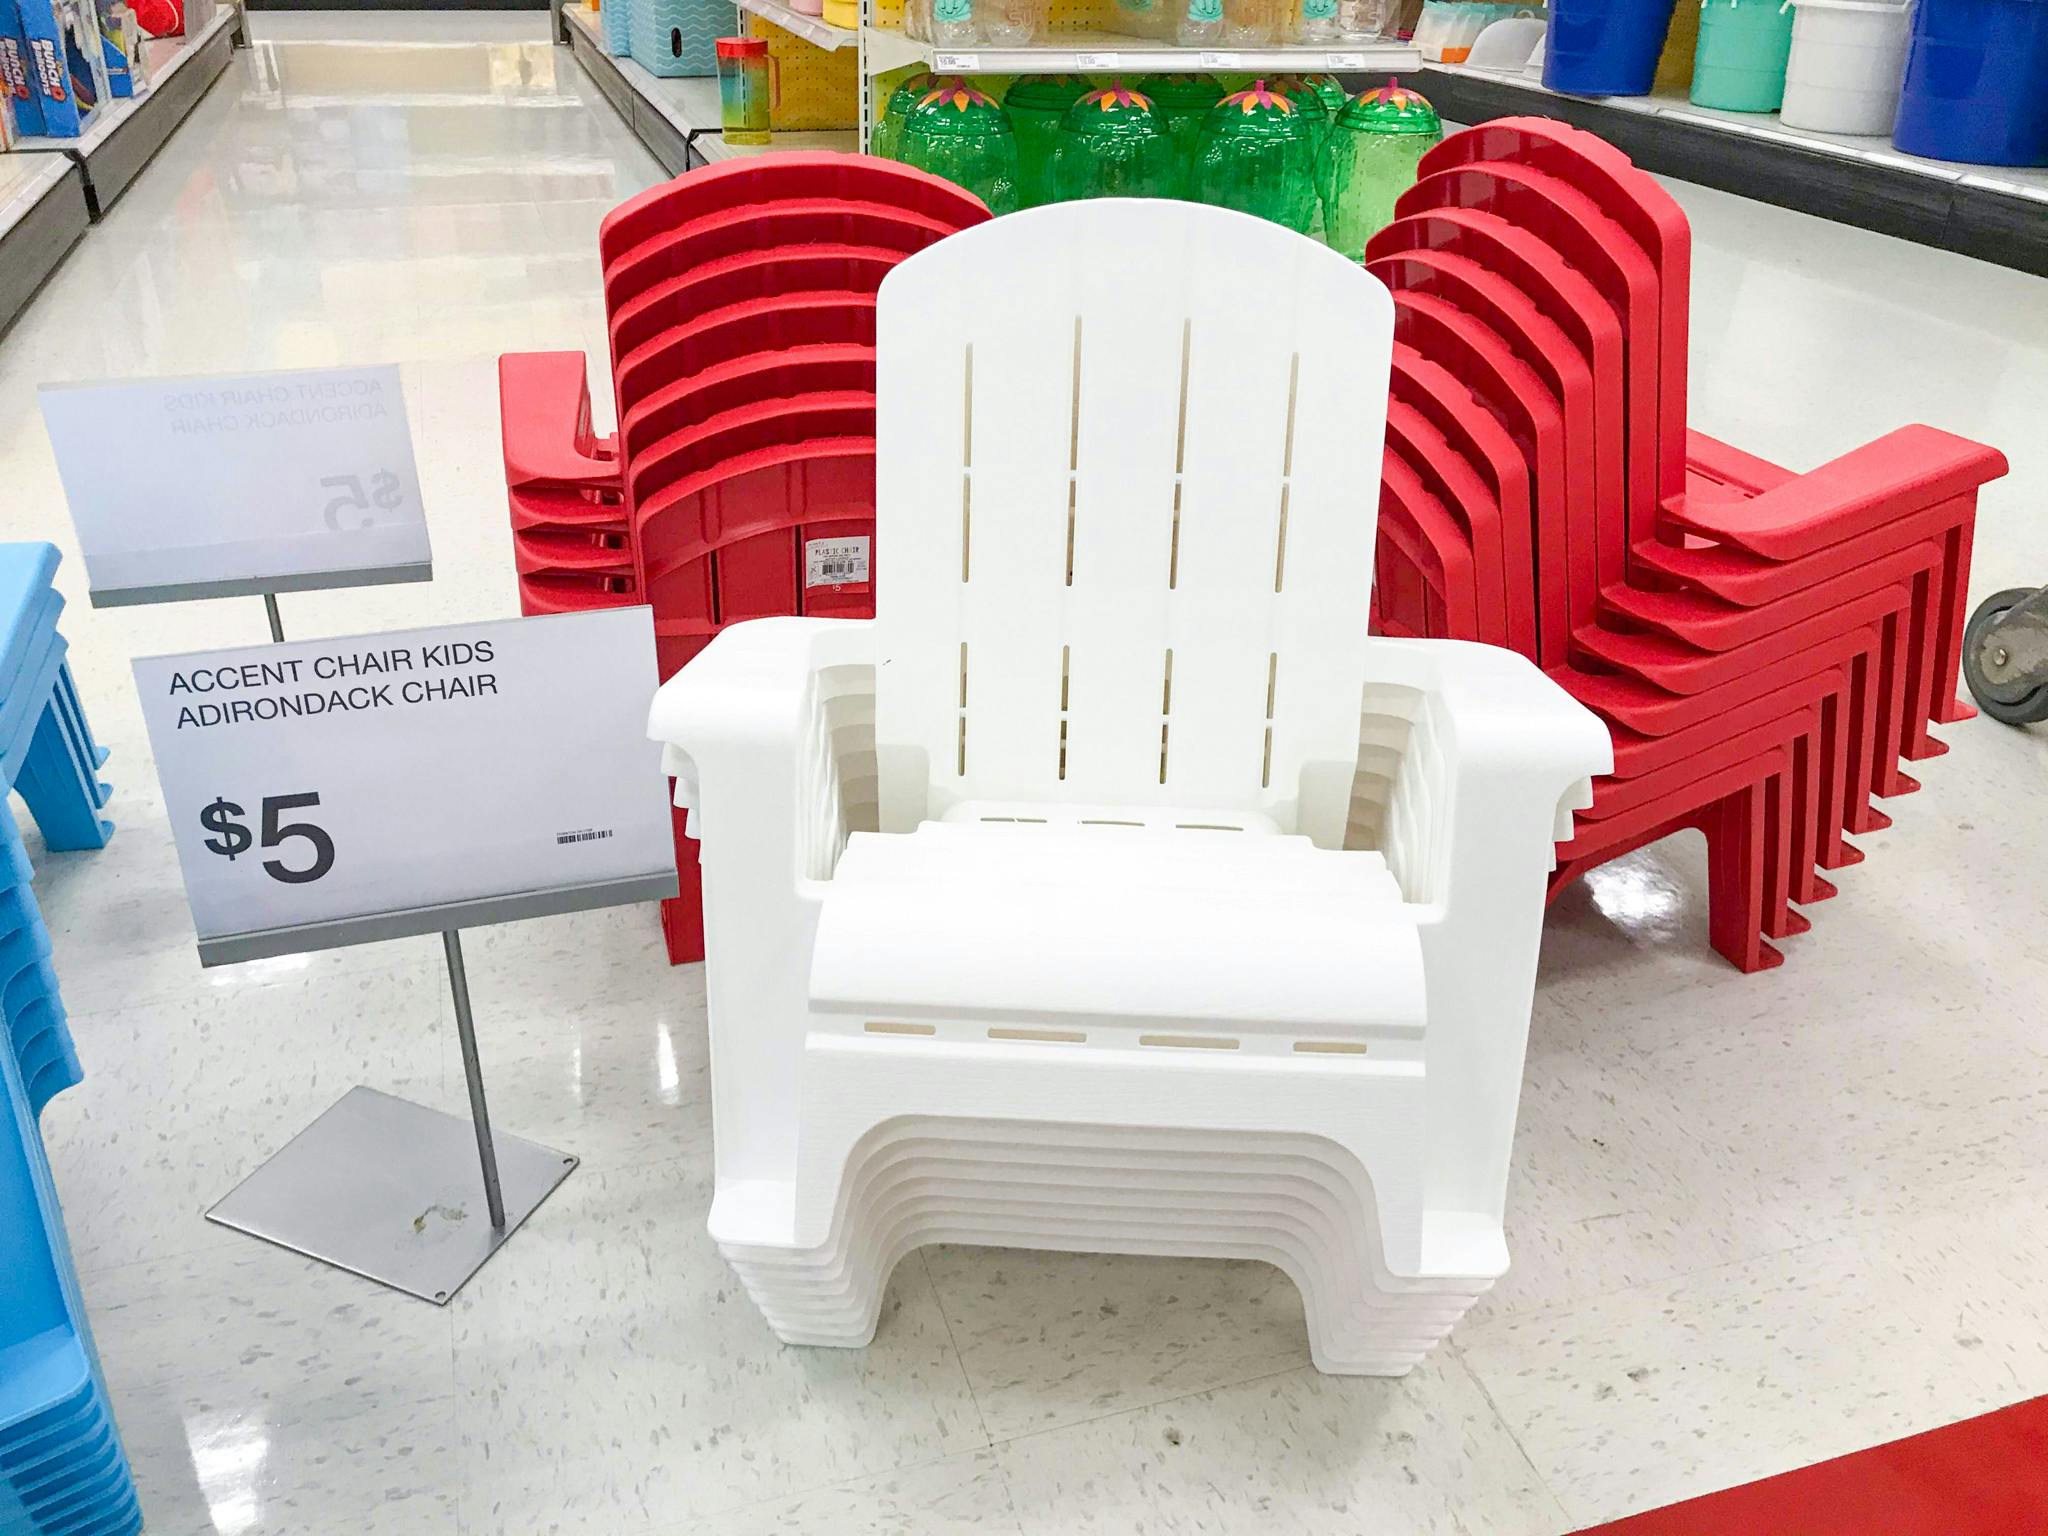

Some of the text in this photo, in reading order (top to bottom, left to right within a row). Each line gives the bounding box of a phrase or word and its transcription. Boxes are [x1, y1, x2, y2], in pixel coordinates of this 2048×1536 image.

[40, 39, 61, 87] BUNCH
[170, 640, 495, 695] ACCENT CHAIR KIDS
[177, 673, 498, 730] ADIRONDACK CHAIR
[200, 791, 336, 885] $5
